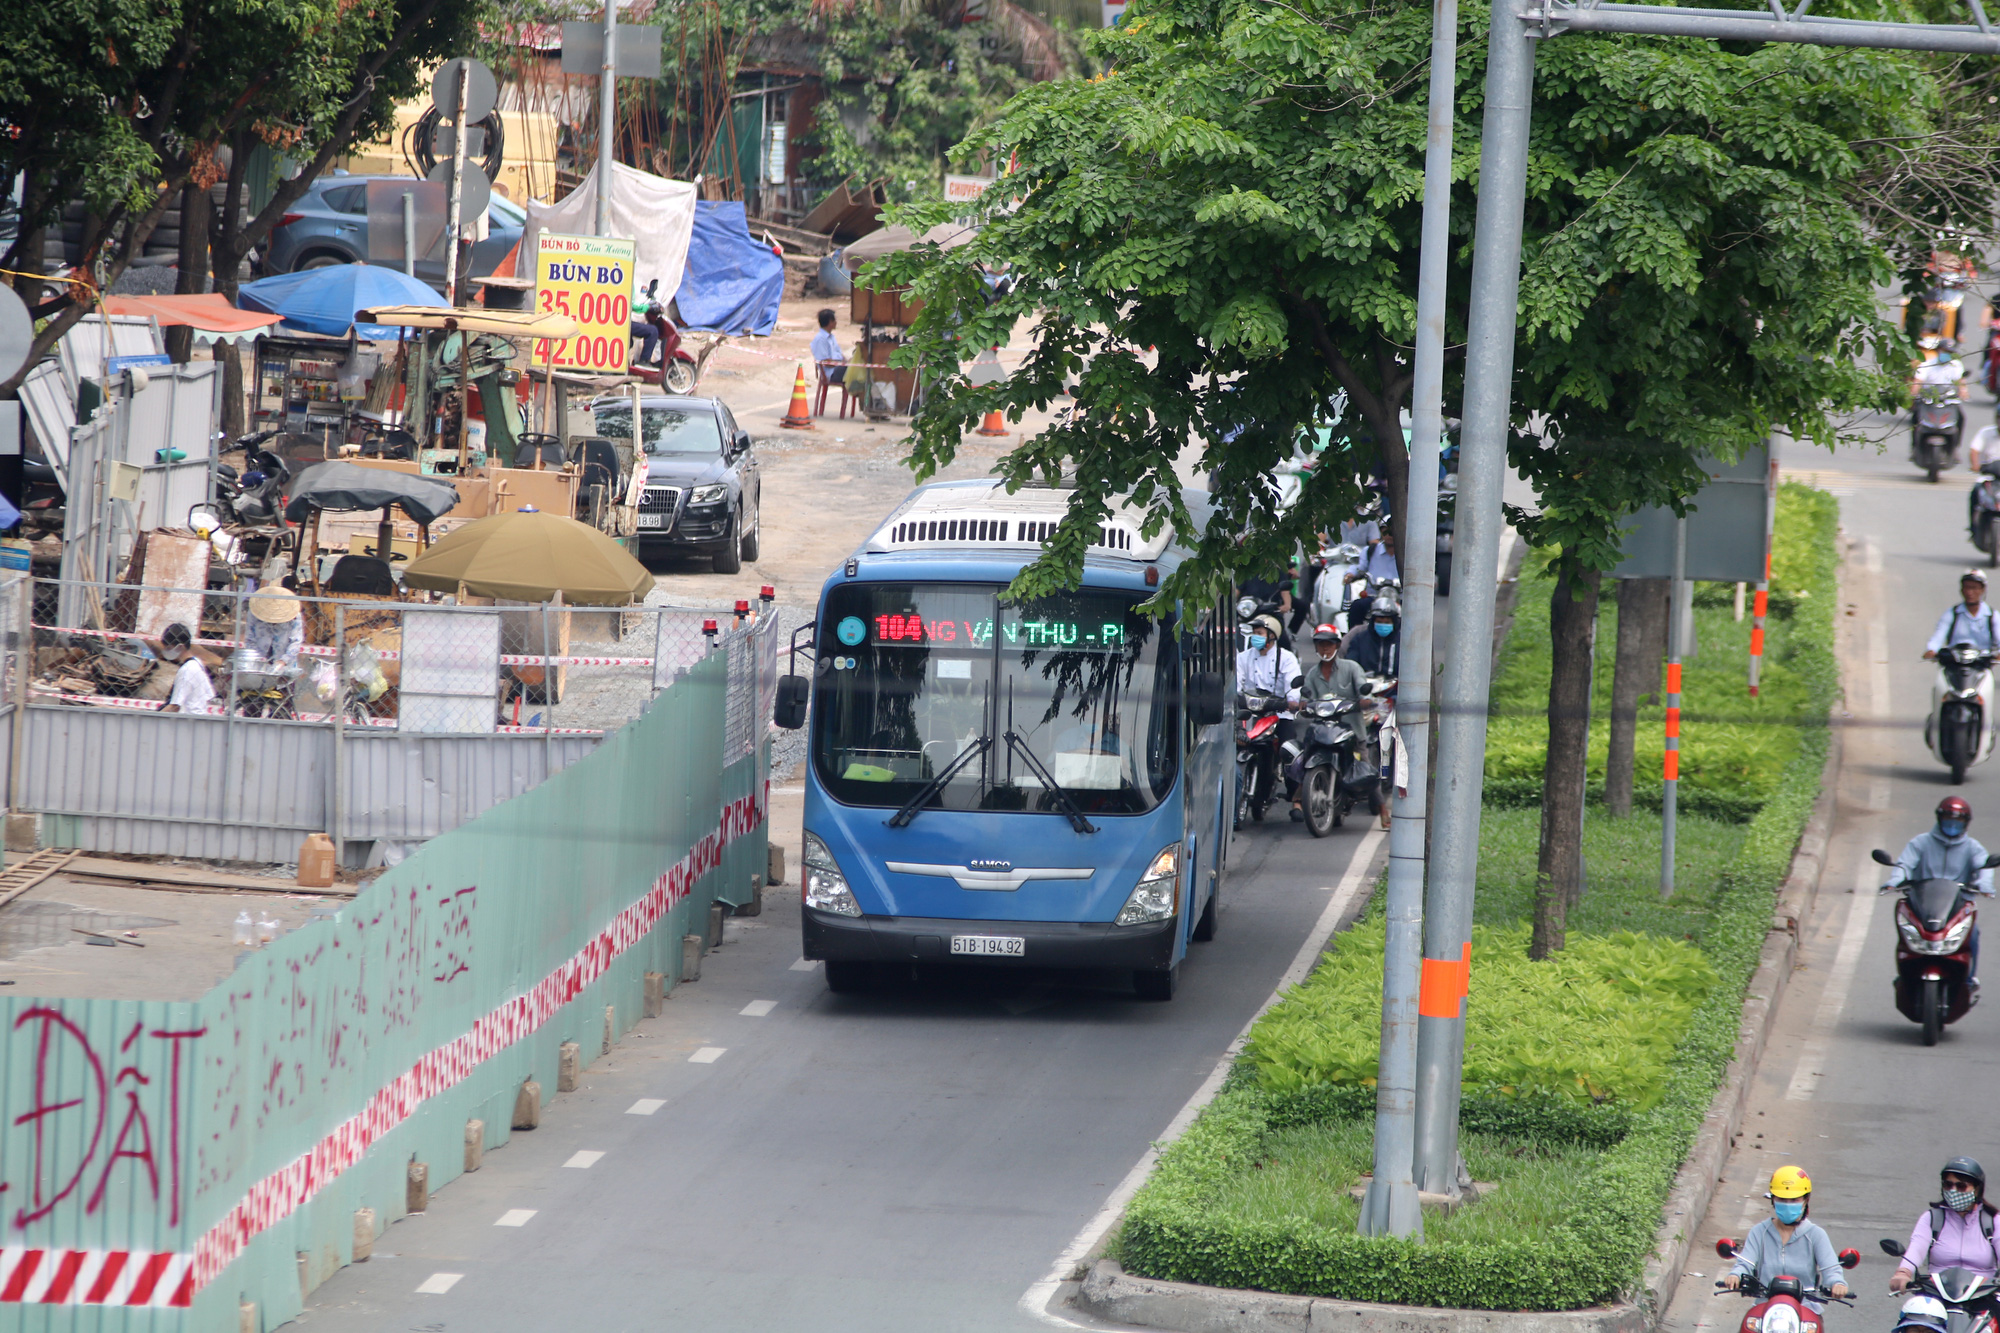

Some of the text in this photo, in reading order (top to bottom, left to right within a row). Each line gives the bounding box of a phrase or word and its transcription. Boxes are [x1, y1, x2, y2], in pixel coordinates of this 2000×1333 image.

[541, 237, 563, 250] BÚN
[566, 238, 580, 251] BÒ
[549, 259, 624, 285] BÚN BÒ
[538, 289, 628, 326] 35.000
[534, 335, 625, 369] 42.000
[1024, 622, 1077, 644] THU
[970, 860, 1011, 869] SAMCO
[953, 938, 1022, 954] 51B-194.92
